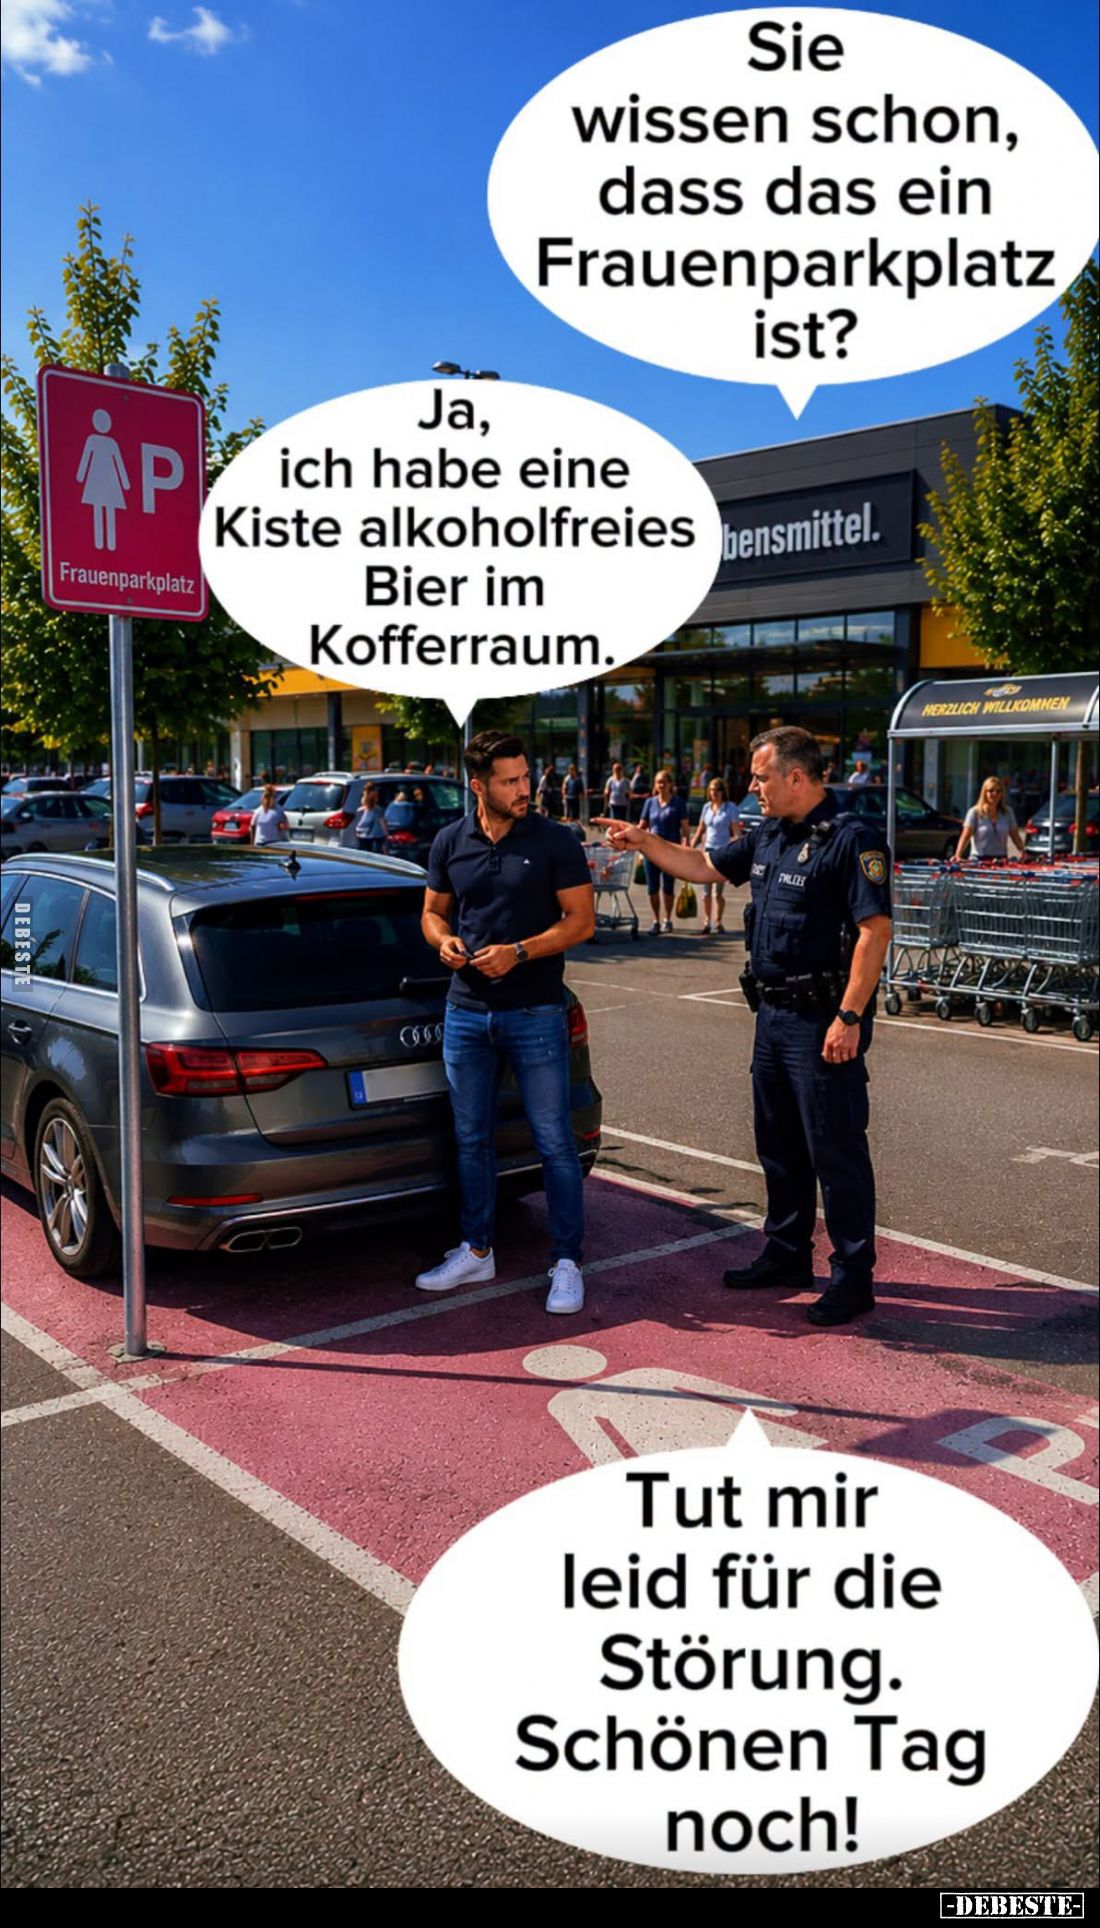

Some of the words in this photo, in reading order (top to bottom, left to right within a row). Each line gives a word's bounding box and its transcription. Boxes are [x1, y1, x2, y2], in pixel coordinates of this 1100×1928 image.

[141, 442, 185, 514] P
[59, 561, 195, 595] Frauenparkplatz
[921, 701, 981, 717] HERZLICH
